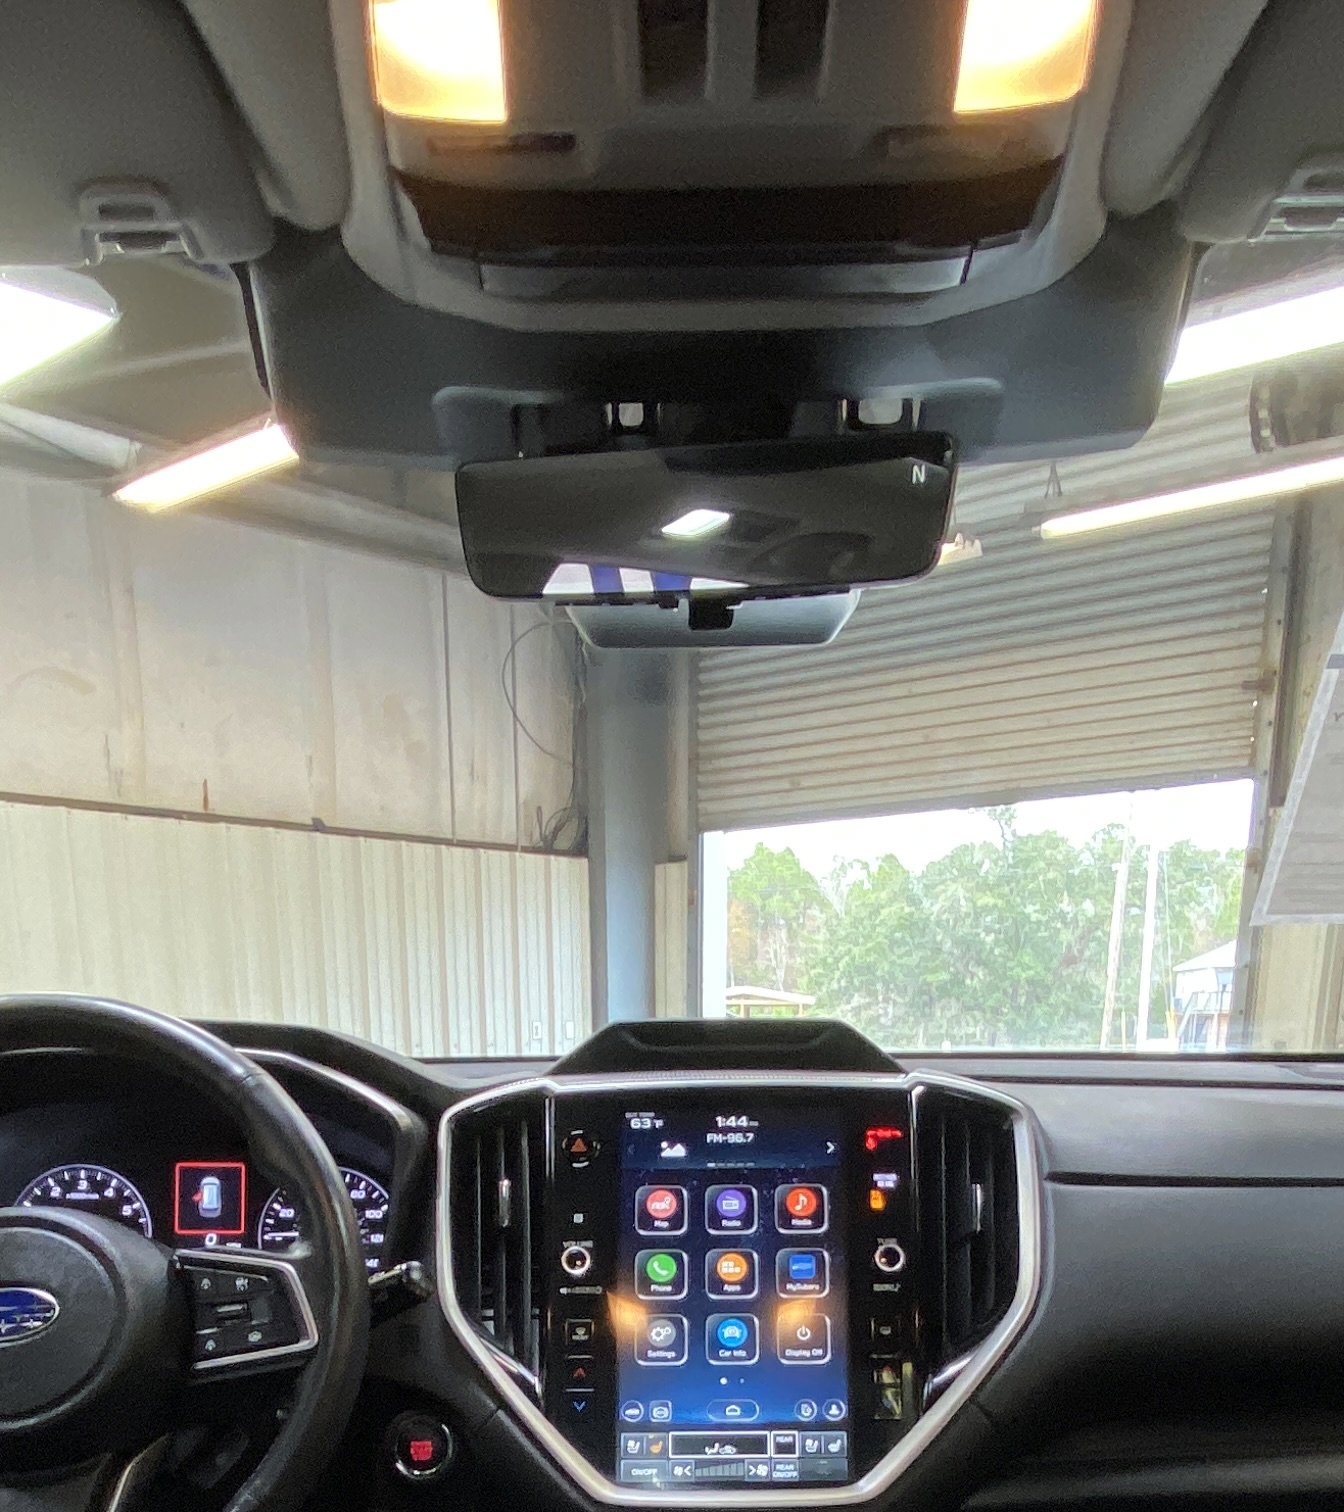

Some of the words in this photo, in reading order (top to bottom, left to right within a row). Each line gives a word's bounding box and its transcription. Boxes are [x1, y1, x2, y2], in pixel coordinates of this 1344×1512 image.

[912, 464, 926, 484] N
[630, 1118, 652, 1129] 63
[715, 1115, 749, 1128] 1:44
[77, 1179, 88, 1191] 3
[50, 1186, 61, 1198] 2
[103, 1187, 114, 1198] 4
[122, 1204, 133, 1217] 5
[205, 1232, 217, 1246] 0
